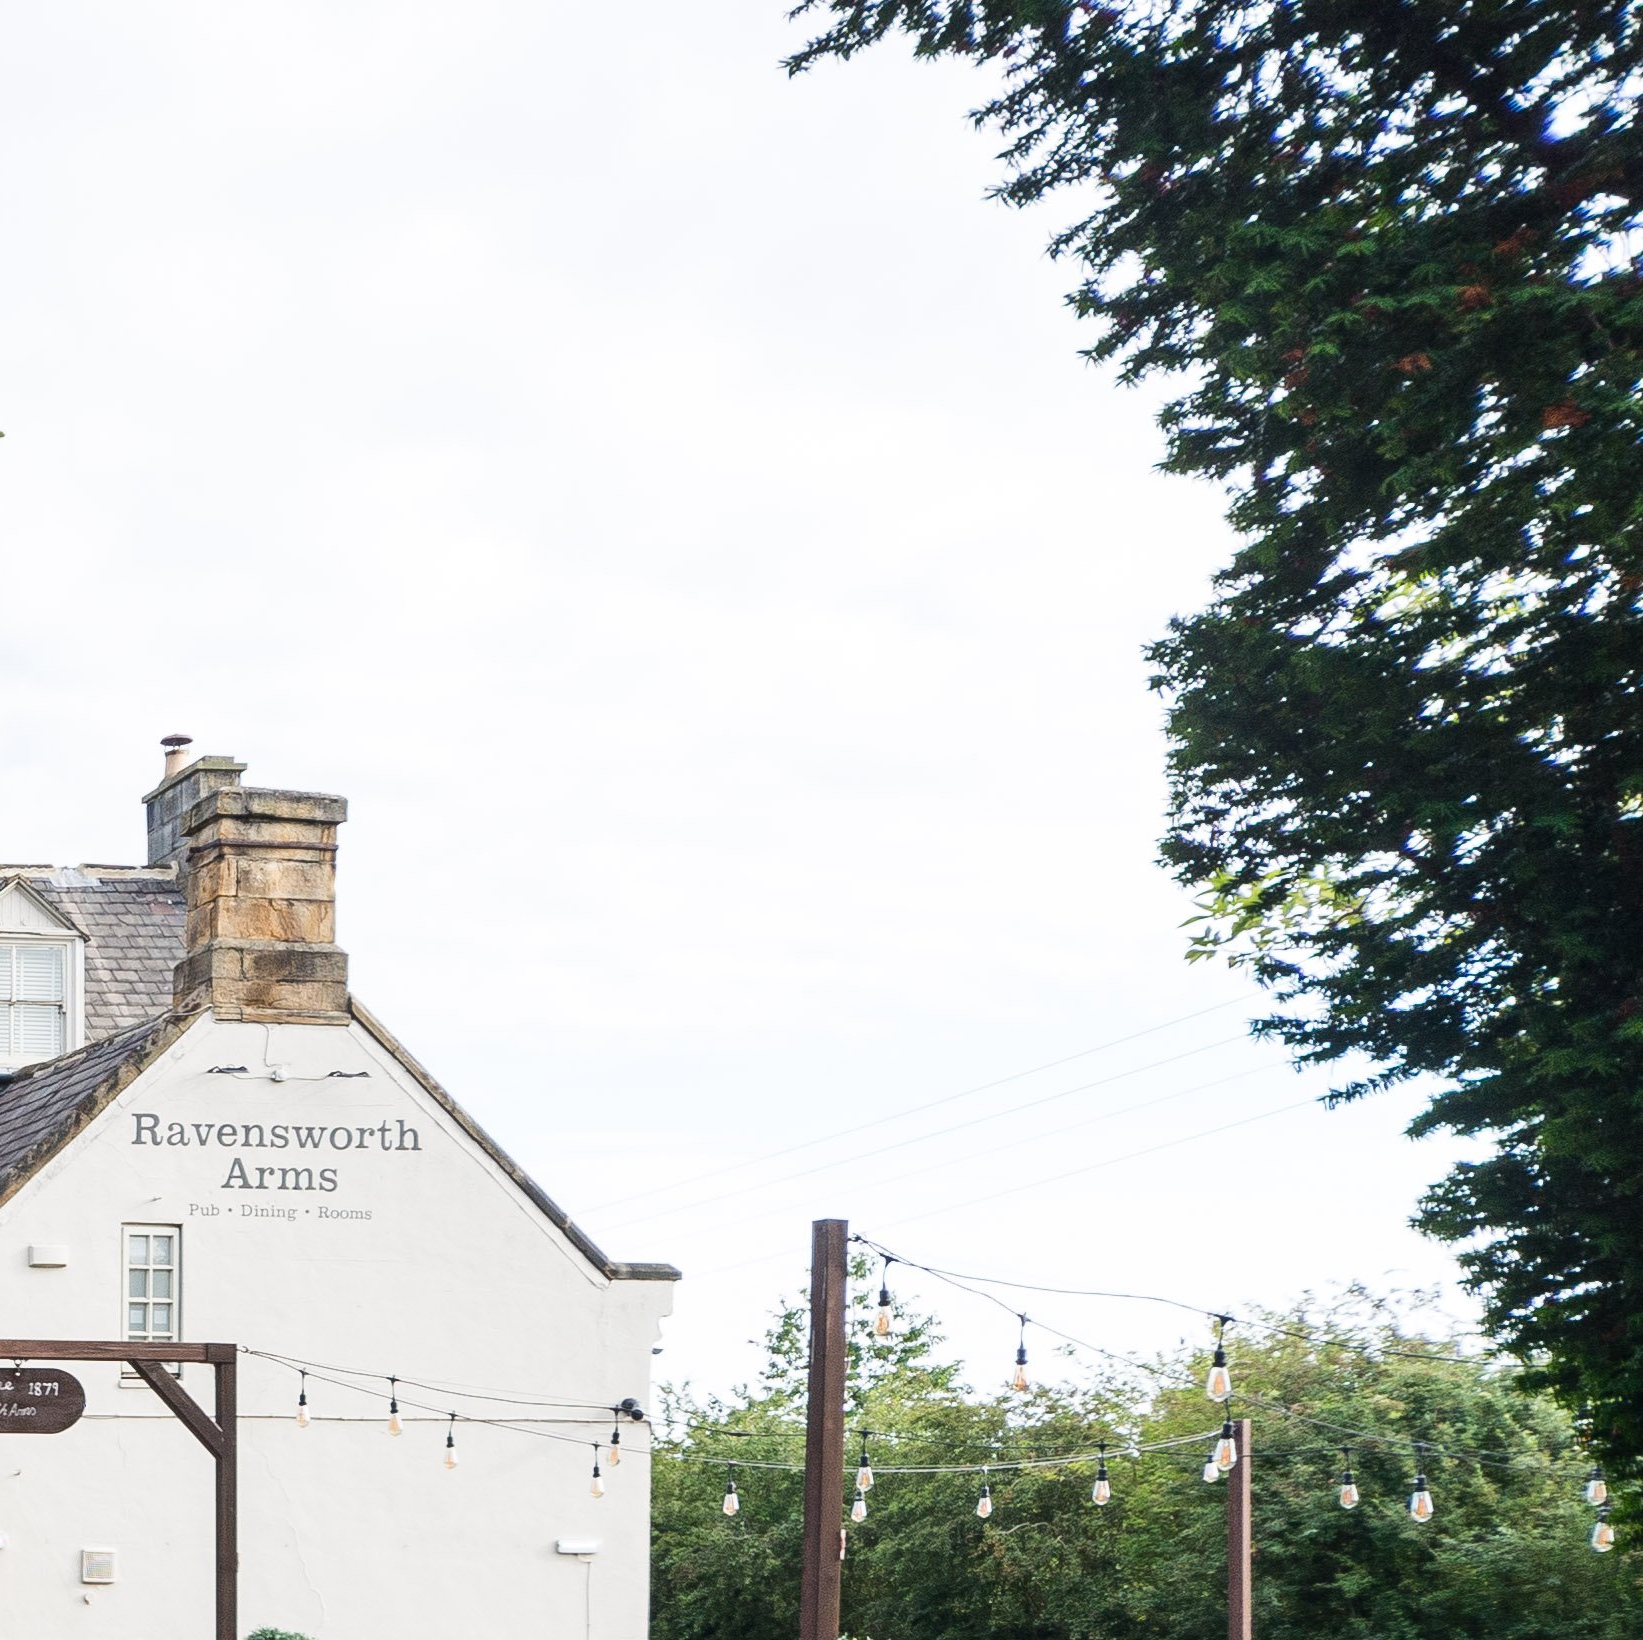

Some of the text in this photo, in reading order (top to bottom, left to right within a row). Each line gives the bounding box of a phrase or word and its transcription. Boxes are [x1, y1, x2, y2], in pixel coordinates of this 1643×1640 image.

[131, 1113, 422, 1151] Ravensworth
[221, 1157, 339, 1192] Arms
[189, 1203, 373, 1221] Pub Dining Rooms
[27, 1381, 59, 1397] 1879
